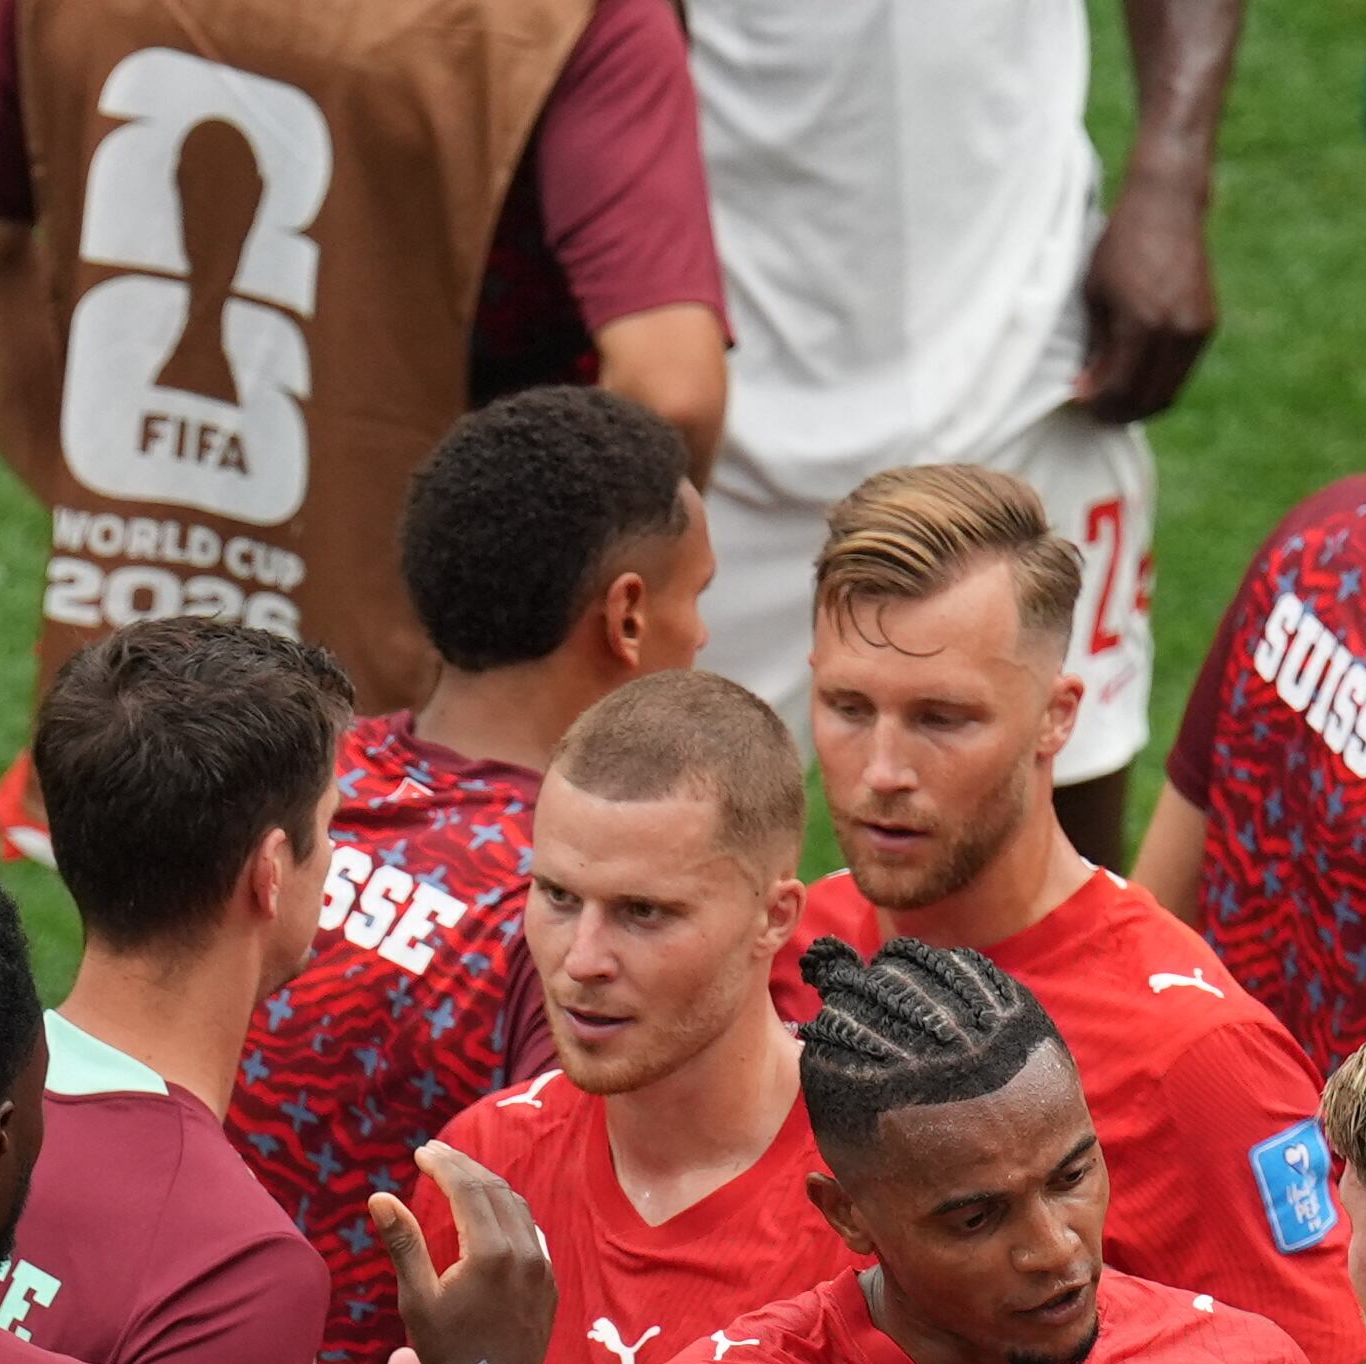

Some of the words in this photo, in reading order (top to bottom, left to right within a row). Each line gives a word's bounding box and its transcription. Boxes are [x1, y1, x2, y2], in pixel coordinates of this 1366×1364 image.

[138, 414, 249, 476] FIFA
[52, 505, 222, 569] WORLD
[223, 536, 306, 592] CUP
[318, 846, 468, 976] SSE
